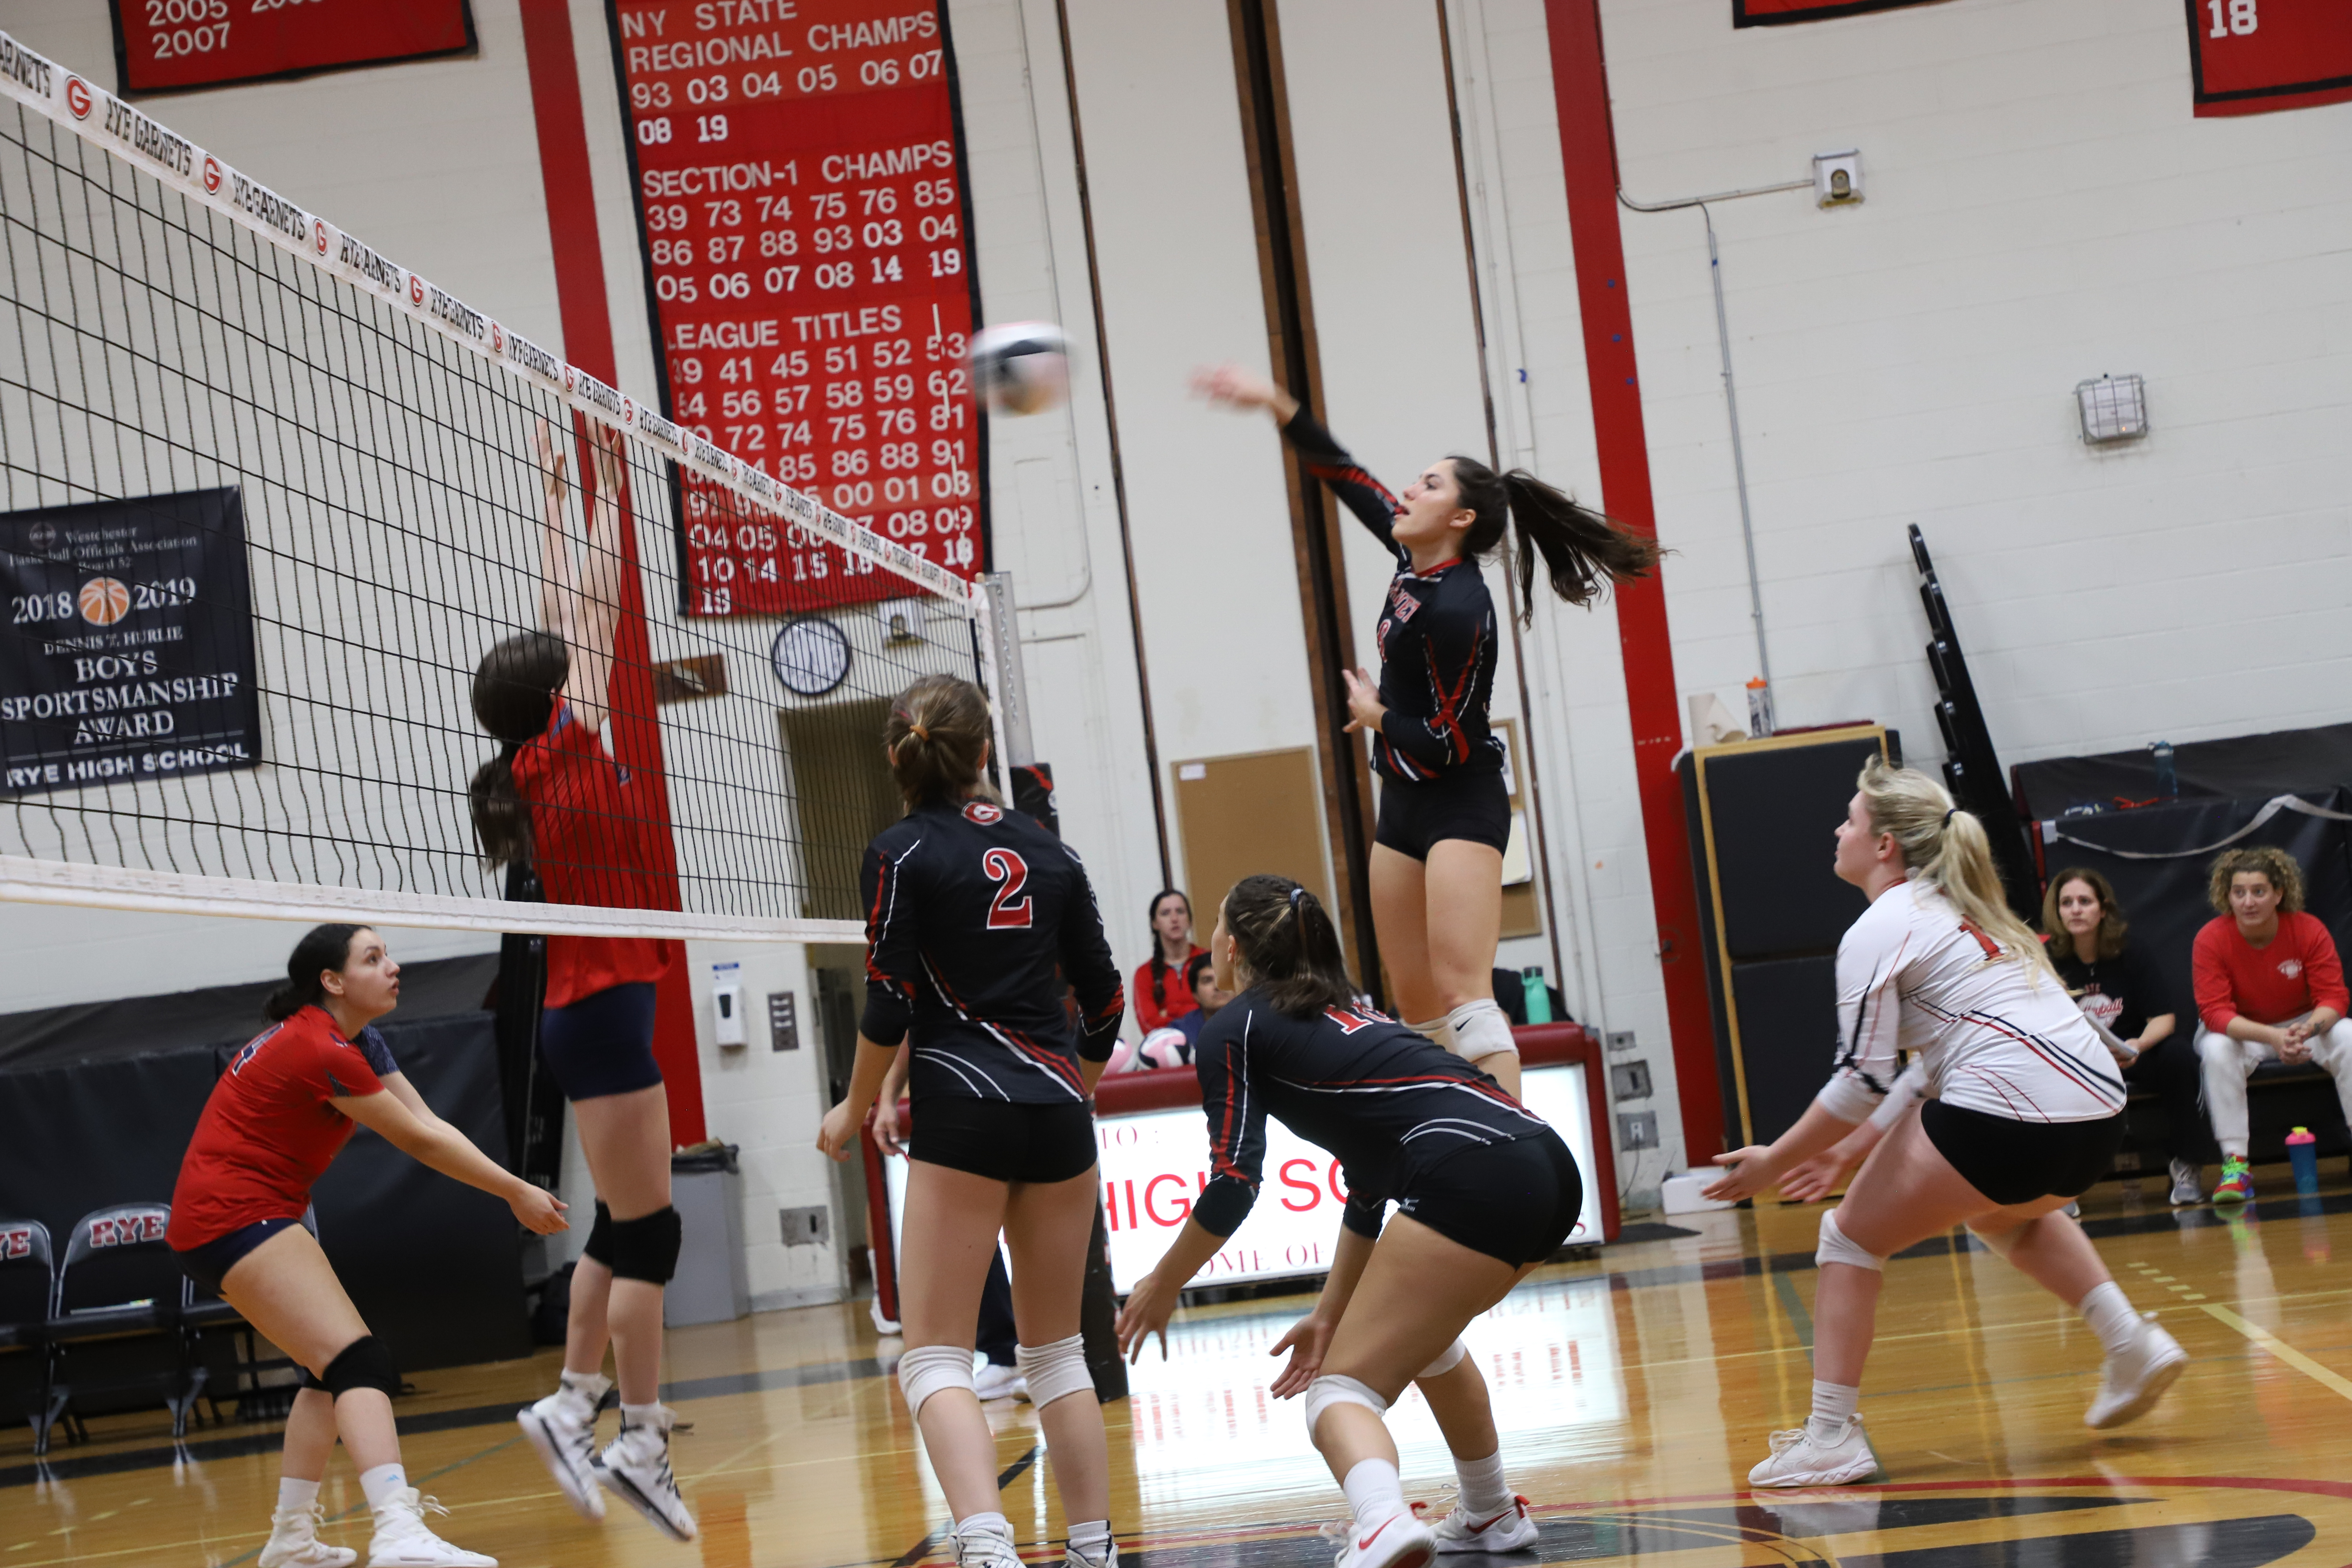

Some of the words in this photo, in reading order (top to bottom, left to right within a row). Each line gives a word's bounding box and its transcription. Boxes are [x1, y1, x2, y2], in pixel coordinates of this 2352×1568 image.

[146, 0, 227, 26] 2005
[622, 10, 666, 38] NY
[695, 0, 798, 31] STATE
[2208, 0, 2258, 38] 18
[152, 21, 231, 58] 2007
[629, 32, 792, 73] REGIONAL
[807, 11, 937, 52] CHAMPS
[0, 37, 50, 99] RNETS
[632, 81, 672, 109] 93
[687, 74, 729, 104] 03
[742, 71, 782, 98] 04
[797, 64, 837, 93] 05
[860, 59, 900, 86] 06
[908, 49, 942, 79] 07
[134, 114, 192, 176] GARNETS
[637, 116, 672, 146] 08
[697, 114, 729, 143] 19
[643, 159, 798, 198] SECTION-1
[822, 140, 952, 184] CHAMPS
[648, 204, 688, 231] 39
[703, 199, 742, 227] 73
[756, 195, 792, 222] 74
[810, 192, 847, 220] 75
[859, 187, 897, 215] 76
[913, 179, 955, 208] 85
[651, 239, 692, 267] 86
[708, 236, 745, 265] 87
[760, 230, 798, 258] 88
[813, 225, 853, 253] 93
[862, 220, 903, 248] 03
[919, 214, 958, 243] 04
[656, 274, 698, 303] 05
[709, 272, 750, 300] 06
[764, 265, 800, 294] 07
[815, 262, 855, 290] 08
[870, 255, 903, 284] 14
[929, 248, 961, 278] 19
[792, 306, 902, 342] TITLES
[719, 356, 752, 384] 41
[771, 350, 809, 380] 45
[825, 346, 859, 373] 51
[873, 339, 912, 366] 52
[926, 332, 966, 361] 53
[723, 389, 761, 418] 56
[775, 384, 812, 415] 57
[826, 381, 864, 409] 58
[874, 375, 914, 402] 59
[927, 368, 968, 397] 62
[725, 424, 766, 452] 72
[777, 419, 812, 449] 74
[828, 414, 866, 444] 75
[877, 408, 917, 435] 76
[930, 403, 964, 431] 81
[779, 453, 818, 482] 85
[831, 450, 870, 478] 86
[880, 442, 920, 469] 88
[931, 438, 965, 466] 91
[834, 481, 873, 509] 00
[884, 475, 919, 502] 01
[689, 523, 729, 550] 04
[736, 524, 777, 551] 05
[888, 509, 928, 538] 08
[698, 555, 734, 582] 10
[743, 557, 777, 583] 14
[793, 551, 828, 581] 15
[12, 591, 73, 624] 2018
[134, 577, 196, 611] 2019
[1, 673, 238, 720] SPORTSMANSHIP
[75, 711, 174, 744] AWARD
[6, 765, 59, 788] RYE
[68, 756, 133, 780] HIGH
[142, 743, 249, 772] SCHOOL
[983, 847, 1032, 929] 2
[89, 1212, 165, 1248] RYE
